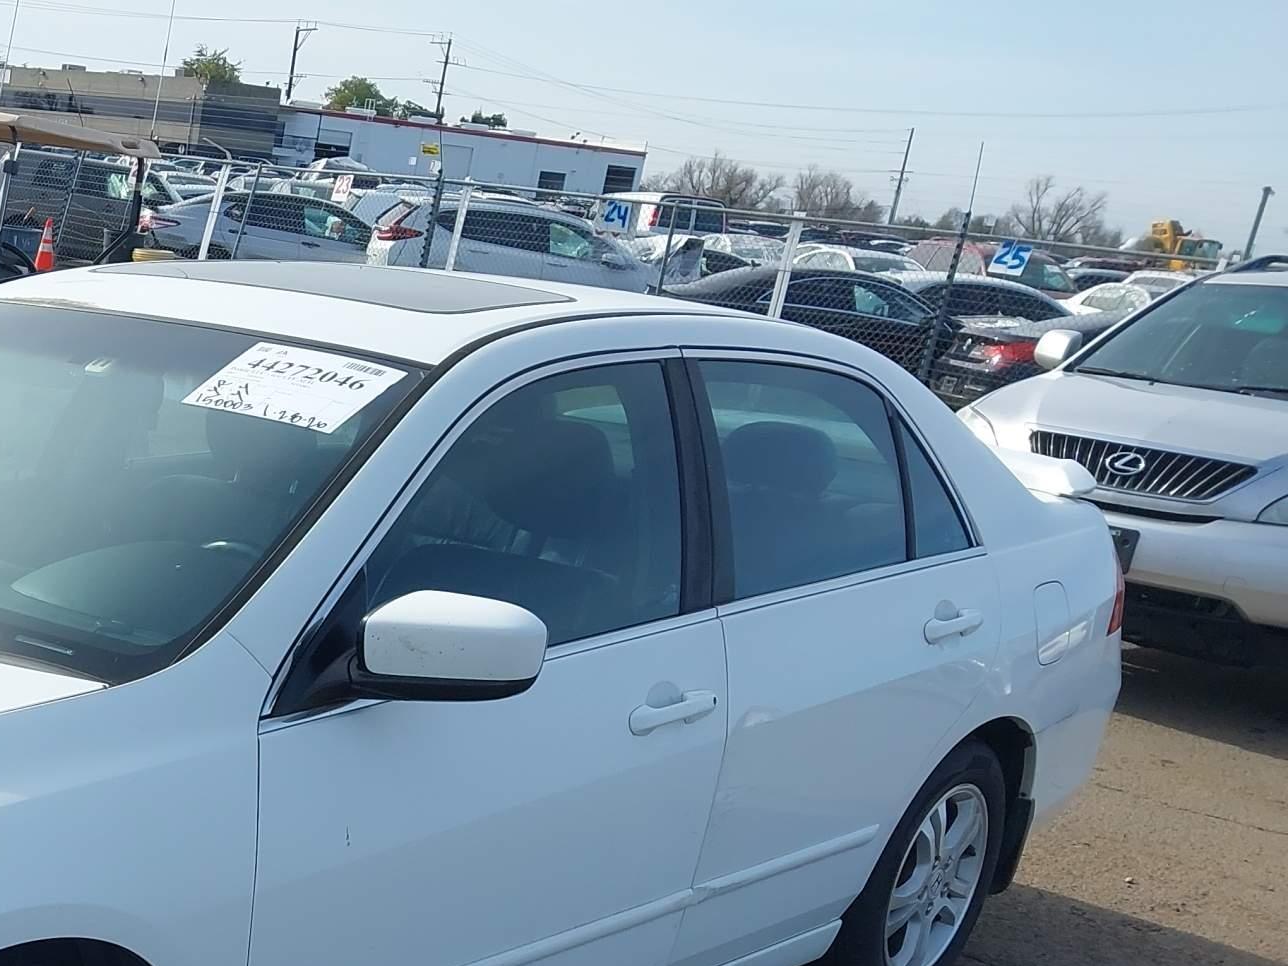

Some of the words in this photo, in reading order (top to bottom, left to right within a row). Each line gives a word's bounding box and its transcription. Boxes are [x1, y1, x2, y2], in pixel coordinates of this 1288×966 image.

[335, 175, 352, 194] 23
[604, 200, 629, 228] 24
[993, 239, 1033, 270] 25
[247, 357, 371, 391] 44272046
